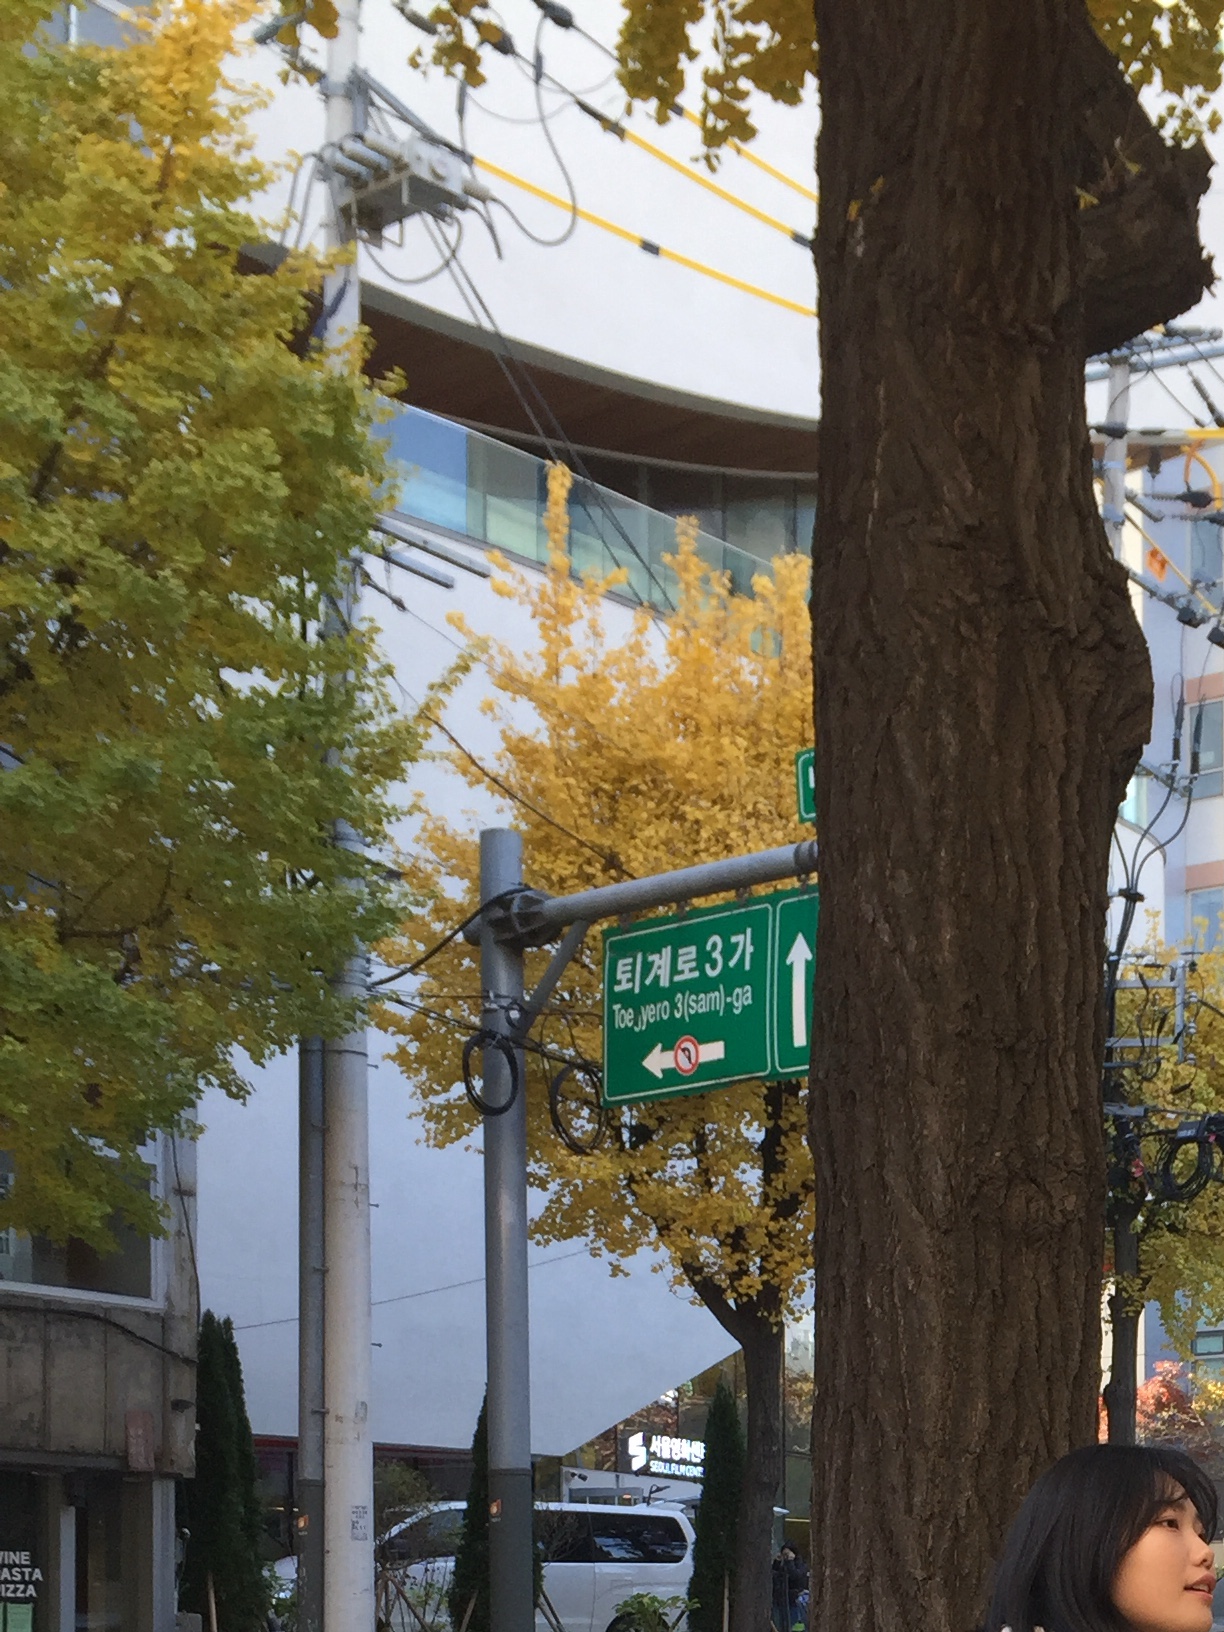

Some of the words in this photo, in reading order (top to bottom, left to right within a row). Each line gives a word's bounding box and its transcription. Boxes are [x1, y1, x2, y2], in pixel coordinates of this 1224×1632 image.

[673, 983, 754, 1023] 3(sam)-ga
[0, 1551, 31, 1565] INE
[0, 1567, 44, 1581] ASTA
[0, 1583, 38, 1598] IZZA
